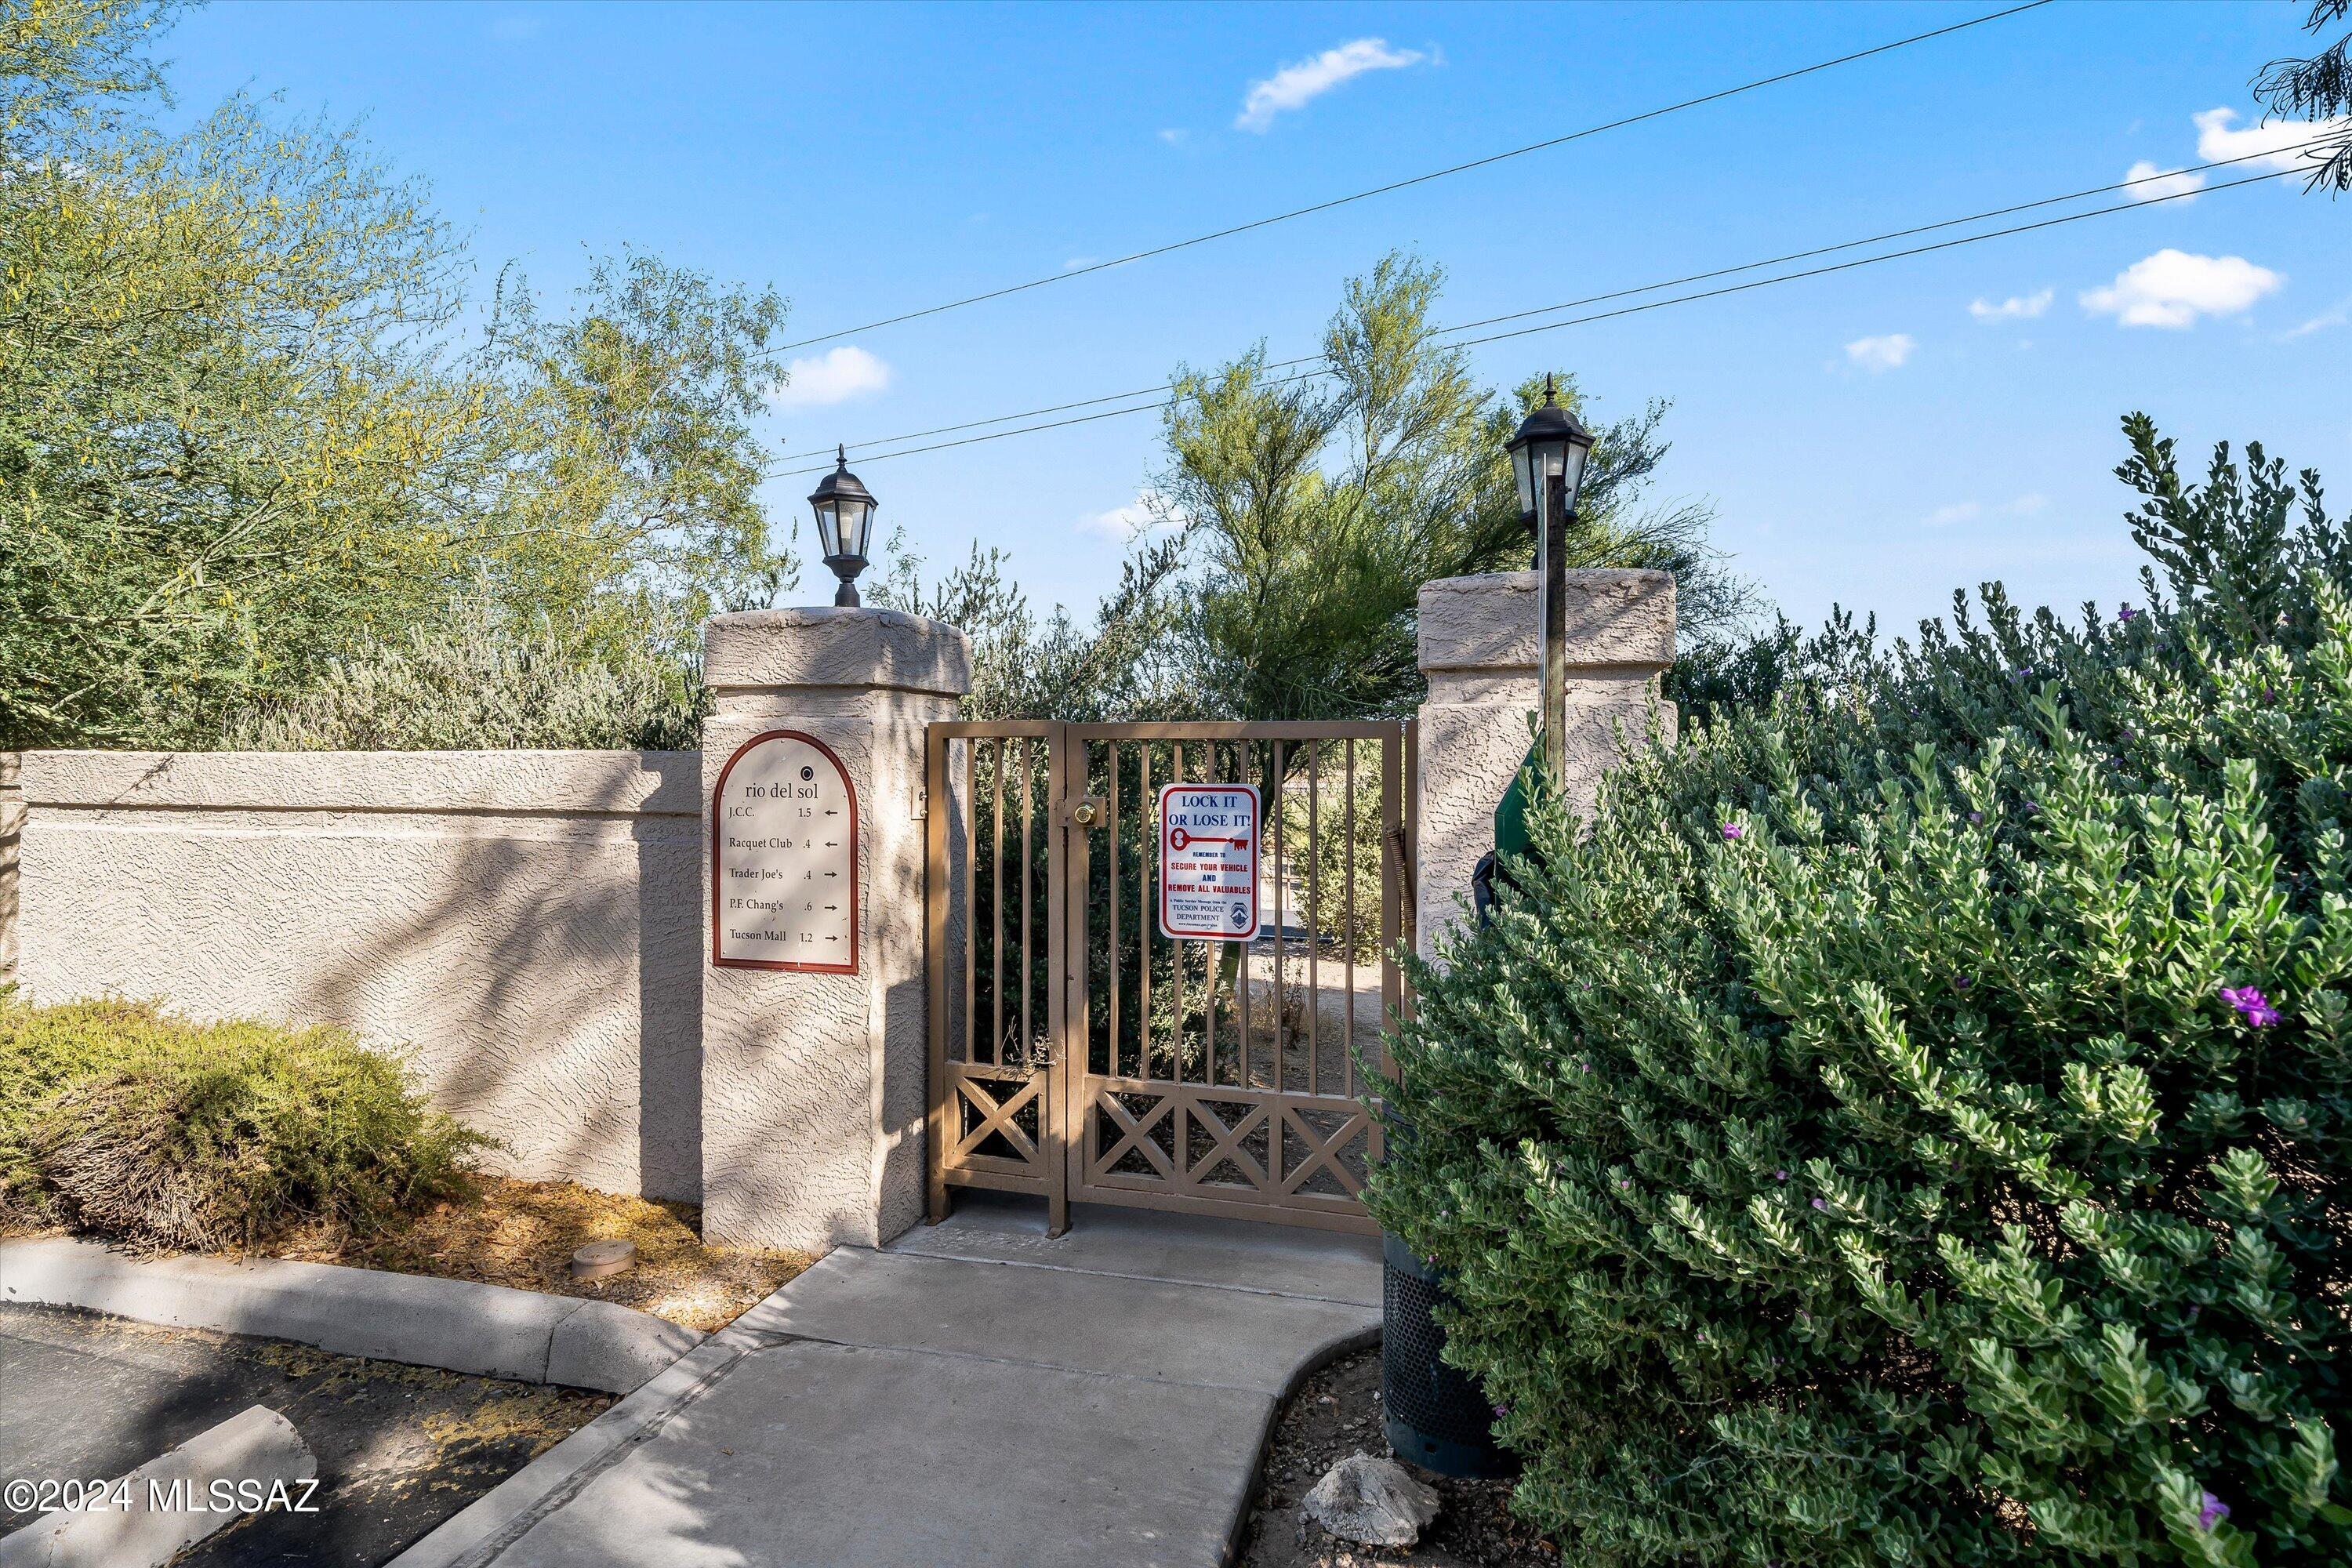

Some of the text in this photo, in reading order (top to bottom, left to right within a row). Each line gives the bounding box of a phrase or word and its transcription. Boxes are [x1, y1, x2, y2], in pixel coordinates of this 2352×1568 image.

[746, 783, 818, 799] rio del sol
[1182, 796, 1237, 808] LOCK IT
[728, 807, 811, 818] J.C.C. 1.5
[1169, 815, 1250, 826] OR LOSE IT!
[729, 837, 811, 850] Racquet Club .4
[729, 869, 811, 880] Trader Joe's .4
[1168, 884, 1195, 892] REMOVE
[1213, 885, 1250, 894] VALUABLES
[730, 899, 812, 913] P.F. Chang's .6
[730, 930, 812, 942] Tucson Mall 1.2
